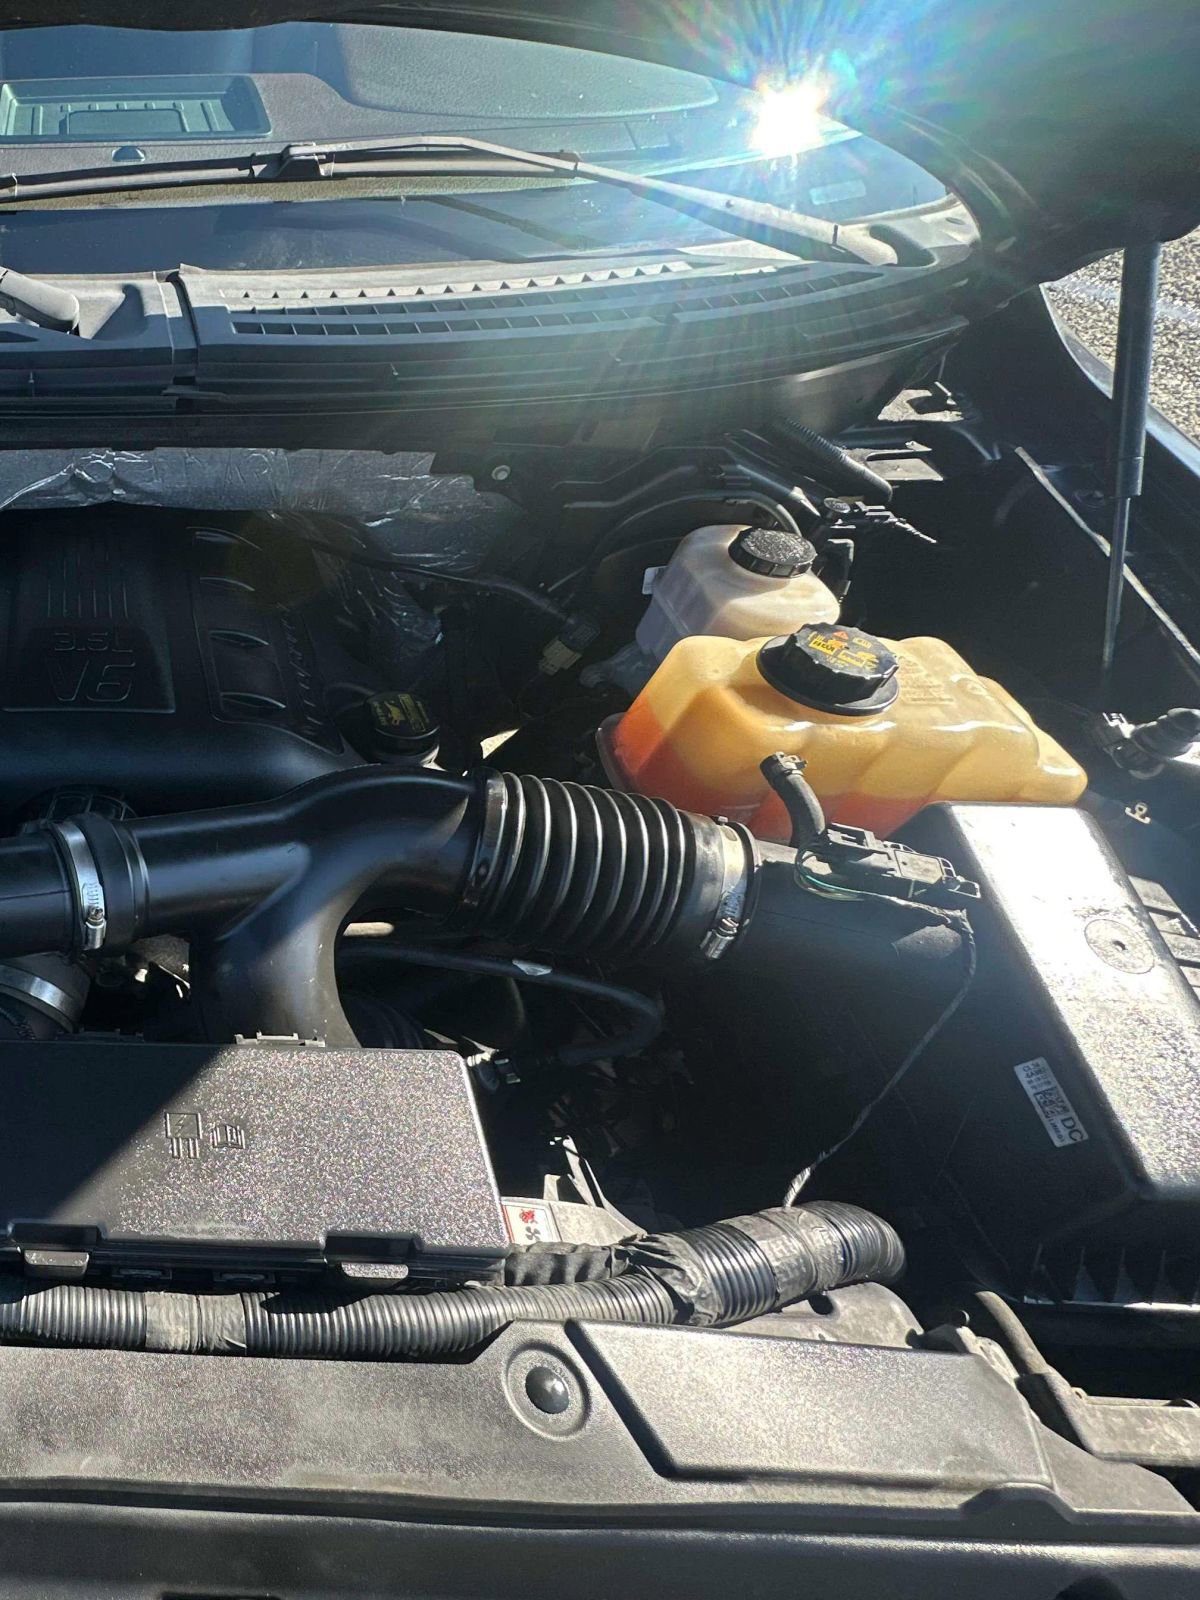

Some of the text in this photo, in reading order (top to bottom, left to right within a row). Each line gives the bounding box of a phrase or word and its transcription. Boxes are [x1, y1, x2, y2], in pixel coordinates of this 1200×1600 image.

[52, 631, 134, 653] 3.5L
[45, 657, 137, 702] V6
[1061, 1116, 1084, 1142] DC
